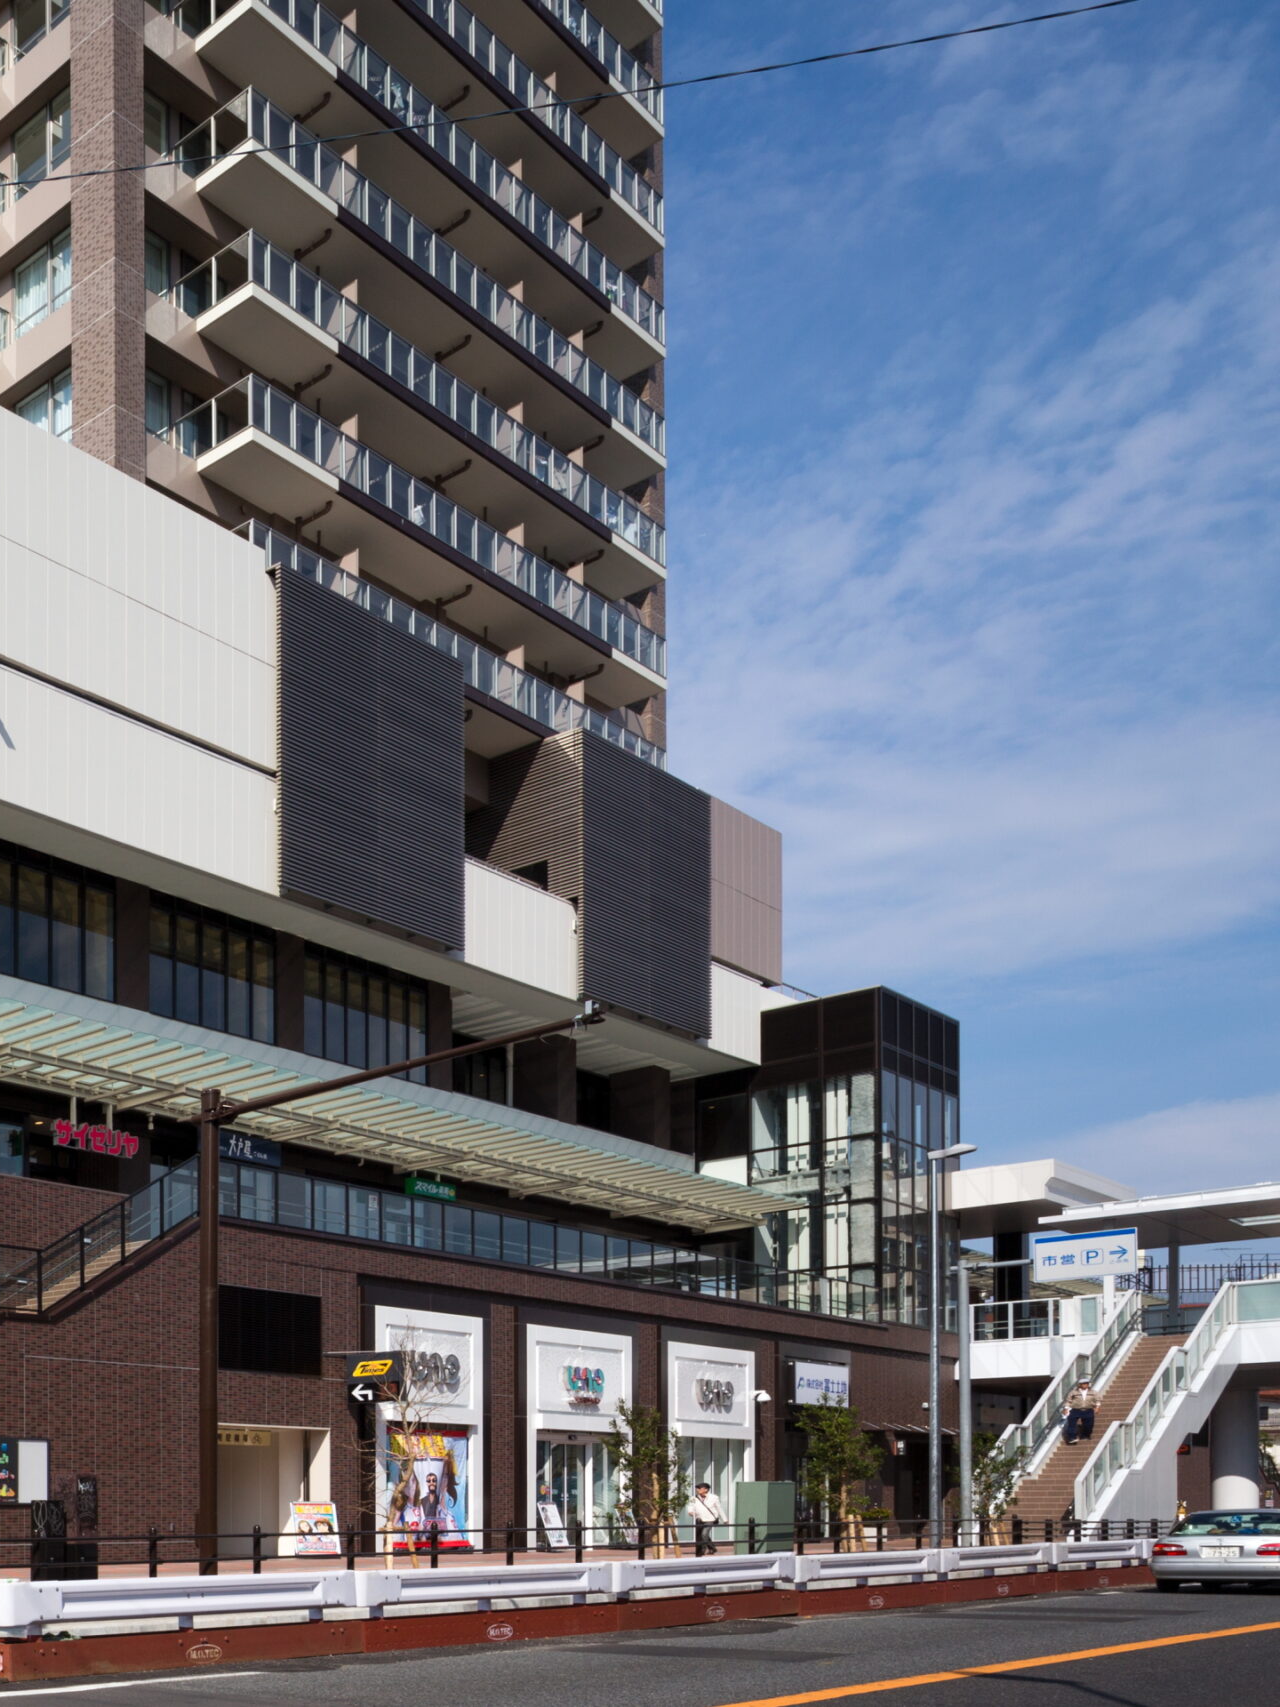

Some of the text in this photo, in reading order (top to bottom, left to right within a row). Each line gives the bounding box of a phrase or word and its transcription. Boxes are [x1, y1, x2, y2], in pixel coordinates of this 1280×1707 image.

[54, 1118, 139, 1159] サイゼリヤ
[1042, 1254, 1075, 1266] 市営
[1086, 1251, 1099, 1264] P
[360, 1363, 386, 1374] Times
